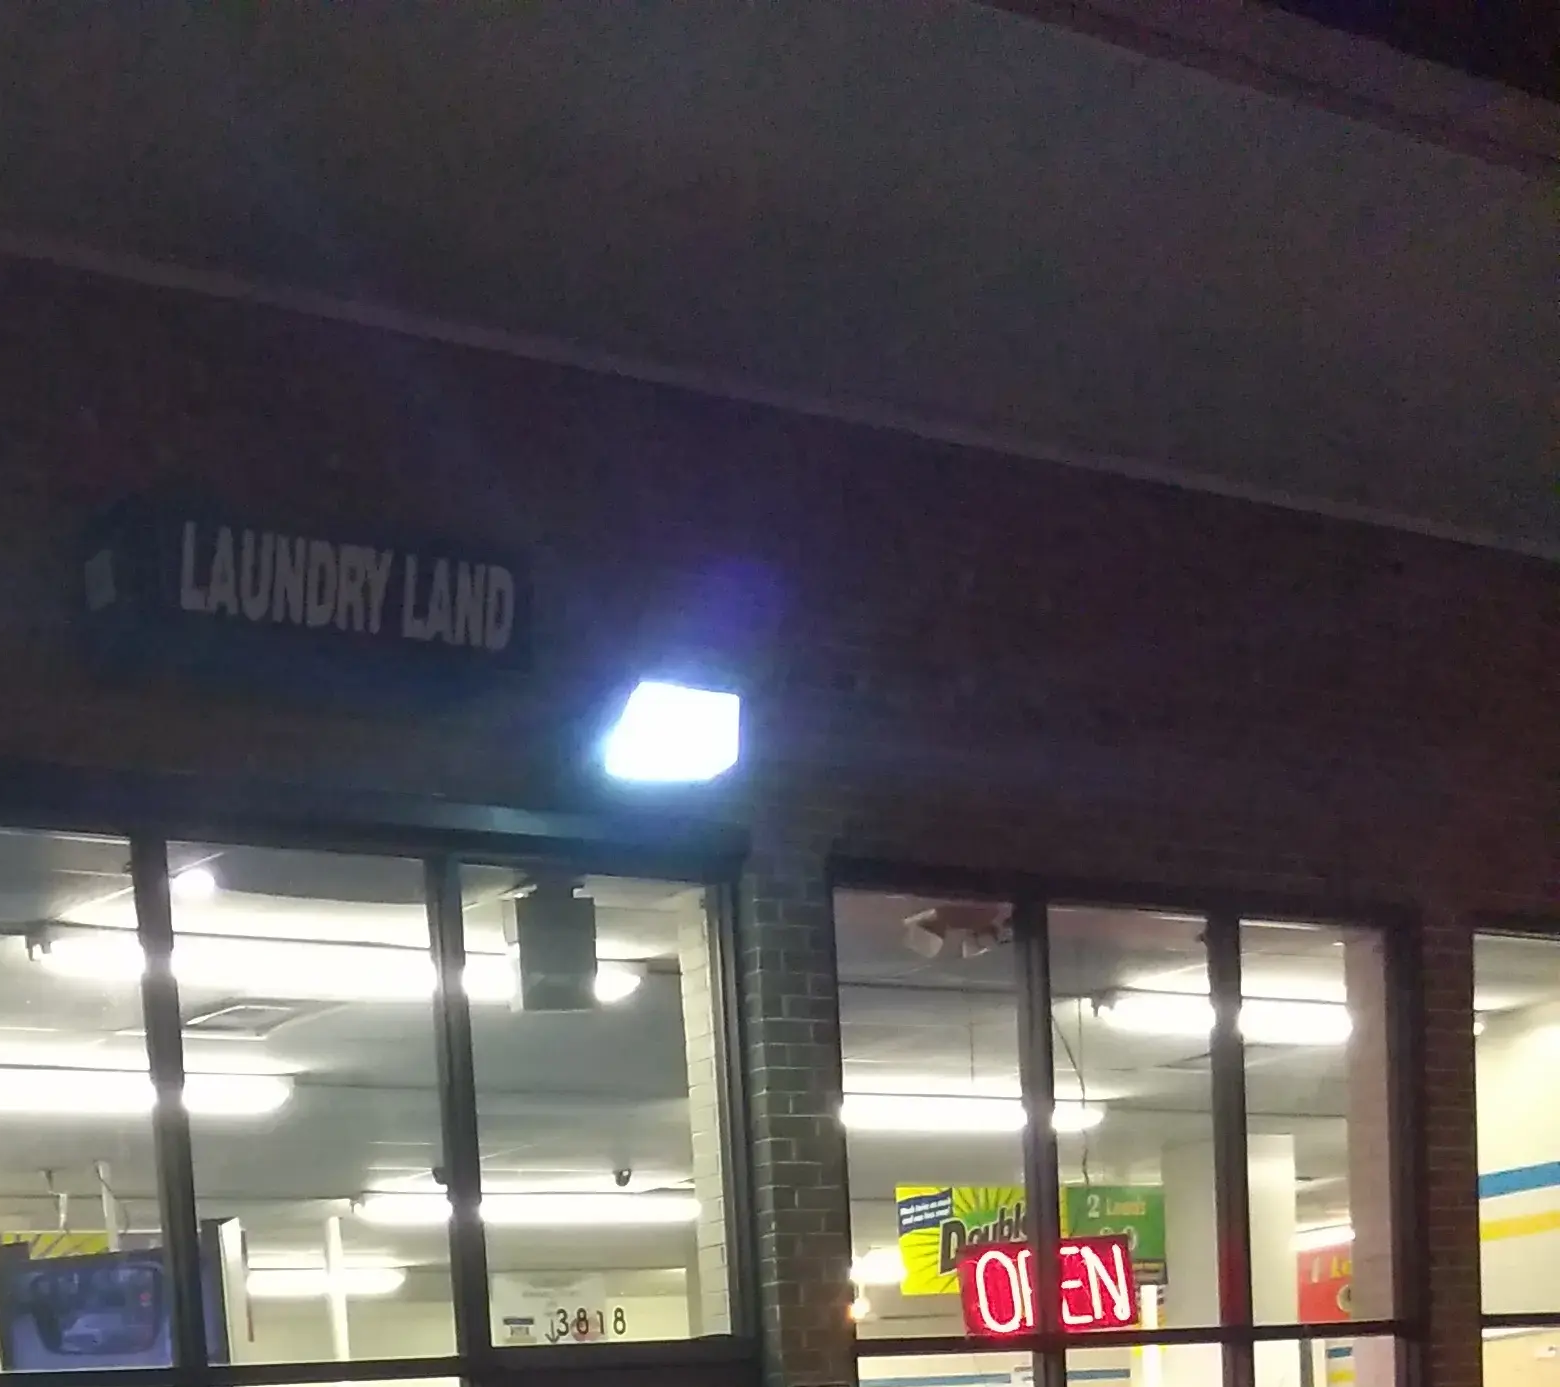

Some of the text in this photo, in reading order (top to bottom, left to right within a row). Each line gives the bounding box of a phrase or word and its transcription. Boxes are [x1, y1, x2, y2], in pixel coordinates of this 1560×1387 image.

[180, 520, 516, 651] LAUNDRY LAND
[938, 1200, 1028, 1274] Doubl
[1087, 1194, 1100, 1219] 2
[556, 1307, 627, 1337] 3818
[975, 1244, 1132, 1333] OPEN
